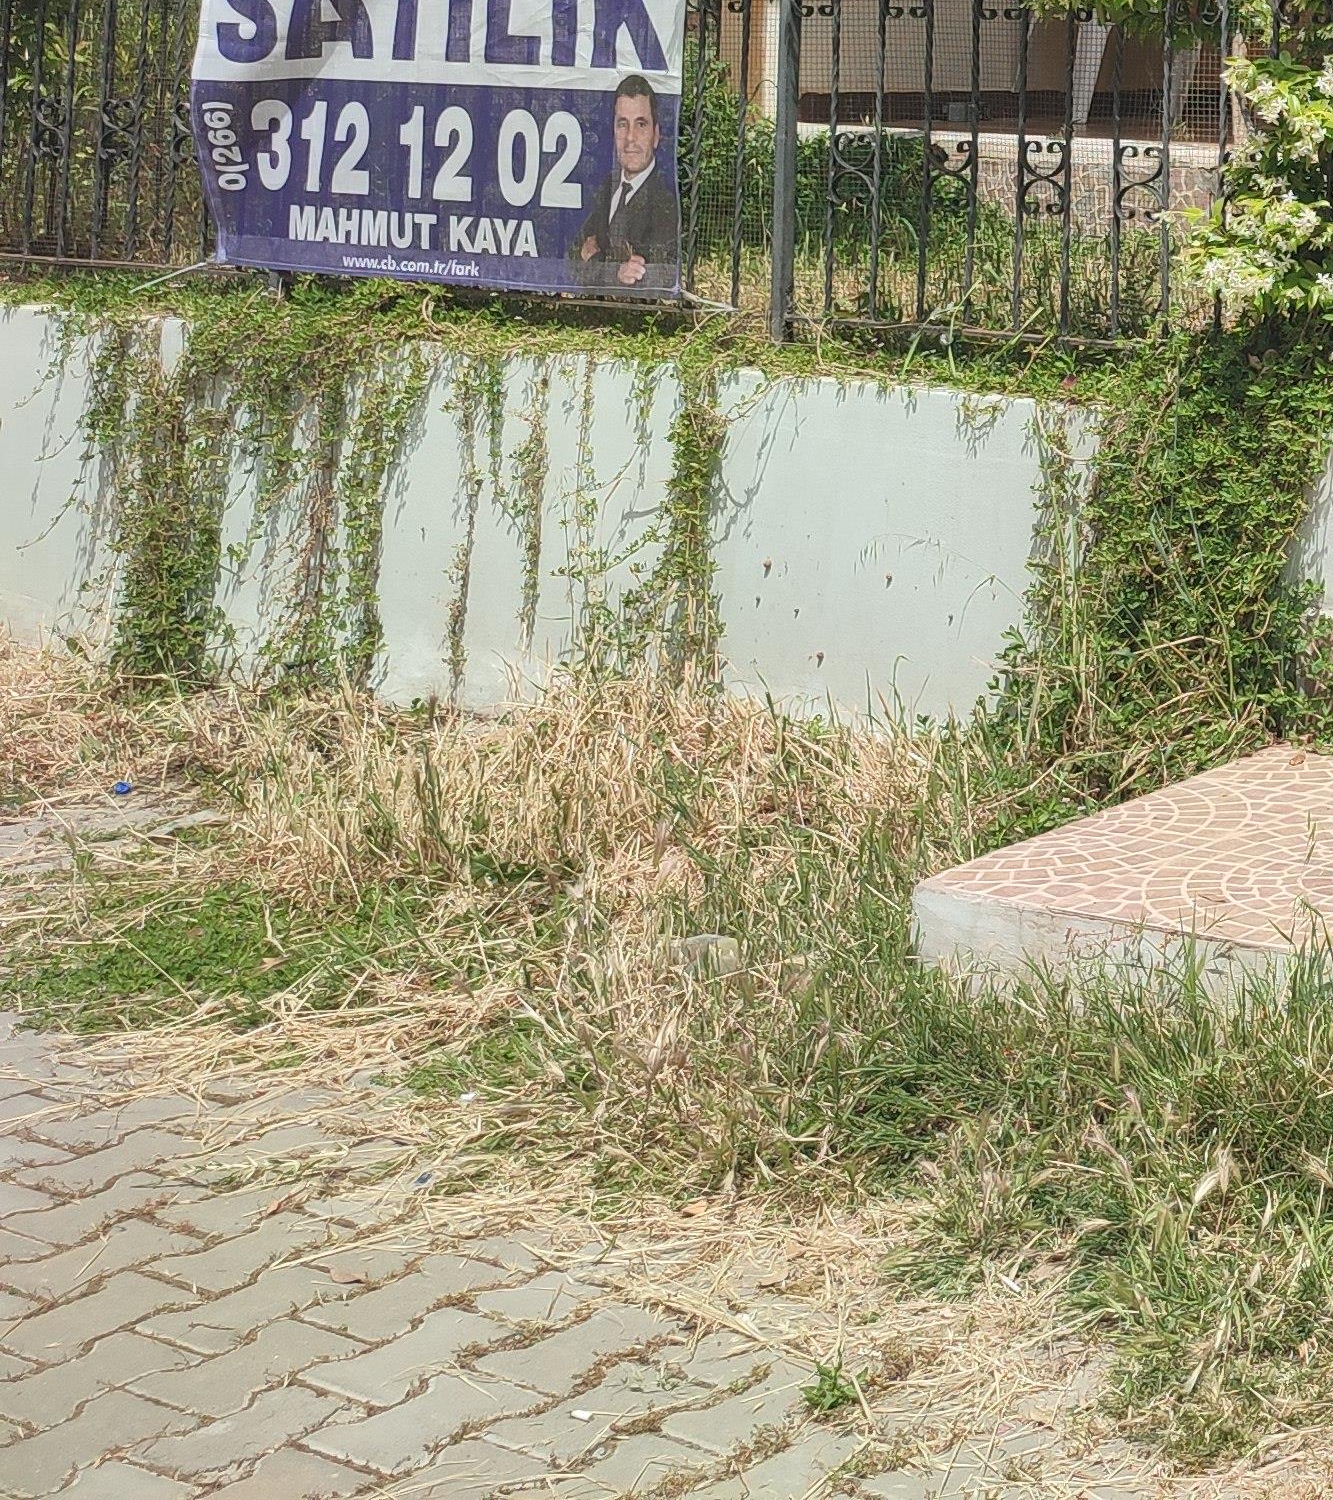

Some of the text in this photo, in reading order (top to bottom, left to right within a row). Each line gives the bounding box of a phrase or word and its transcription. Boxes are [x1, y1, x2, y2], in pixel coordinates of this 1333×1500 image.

[251, 99, 584, 209] 312 12 02
[288, 205, 539, 258] MAHMUT KAYA
[342, 254, 480, 277] www.cb.com.tr/fark
